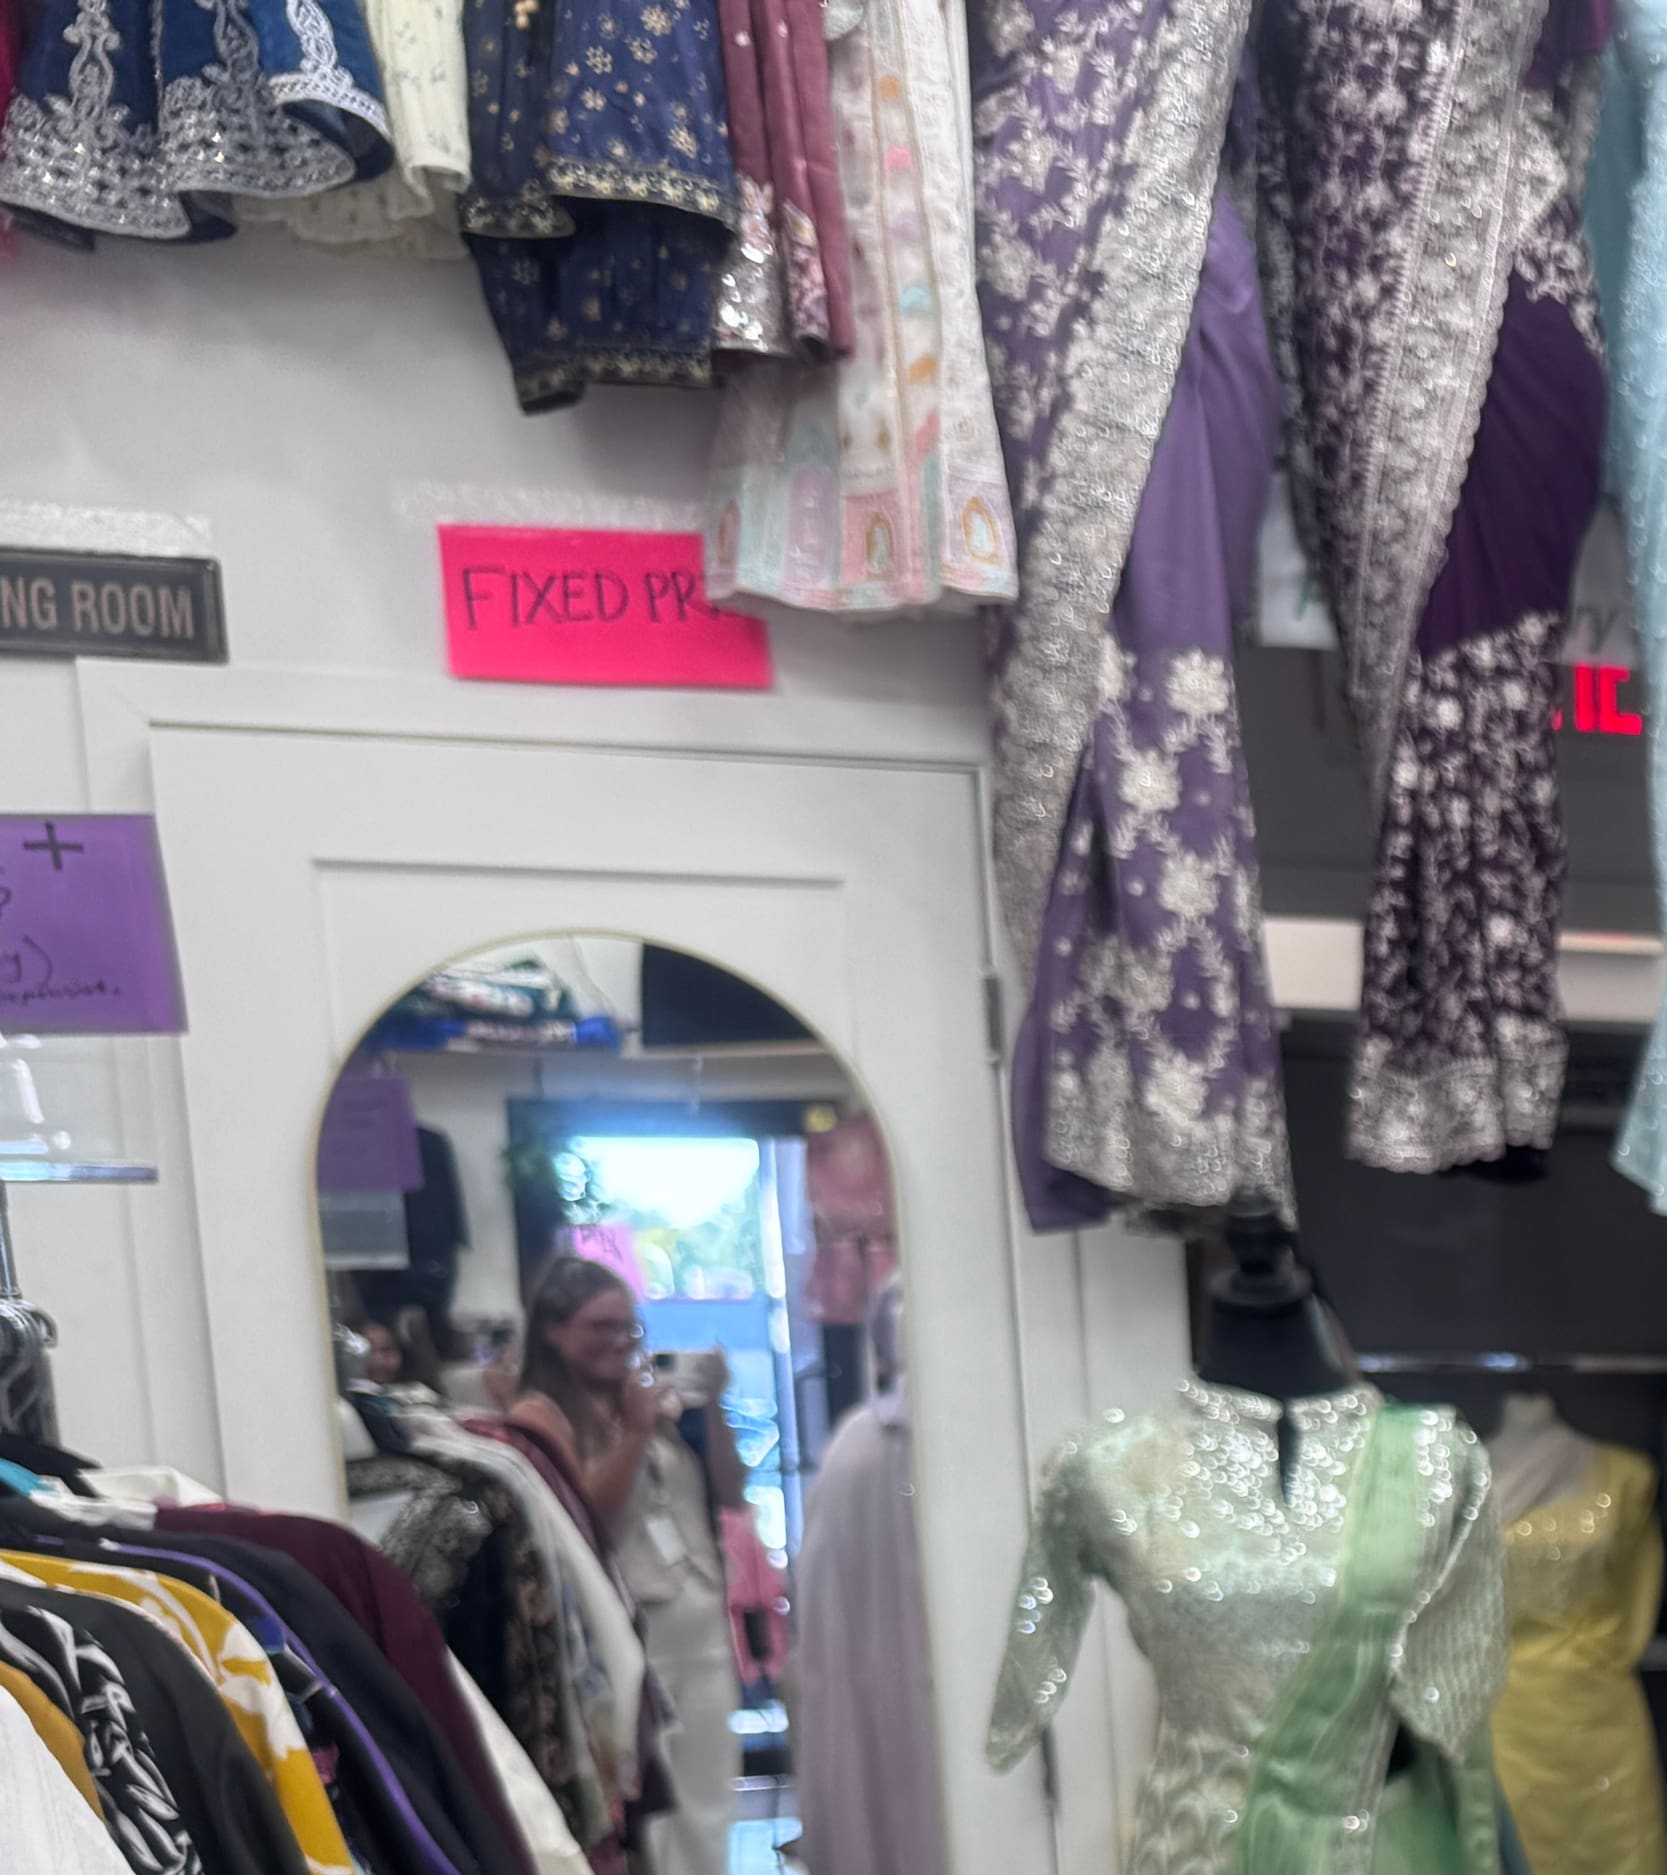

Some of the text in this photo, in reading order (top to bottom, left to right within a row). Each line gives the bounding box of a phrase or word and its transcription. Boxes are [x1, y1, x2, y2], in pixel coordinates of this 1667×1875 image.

[71, 579, 195, 641] ROOM
[463, 566, 721, 630] FIXED PR
